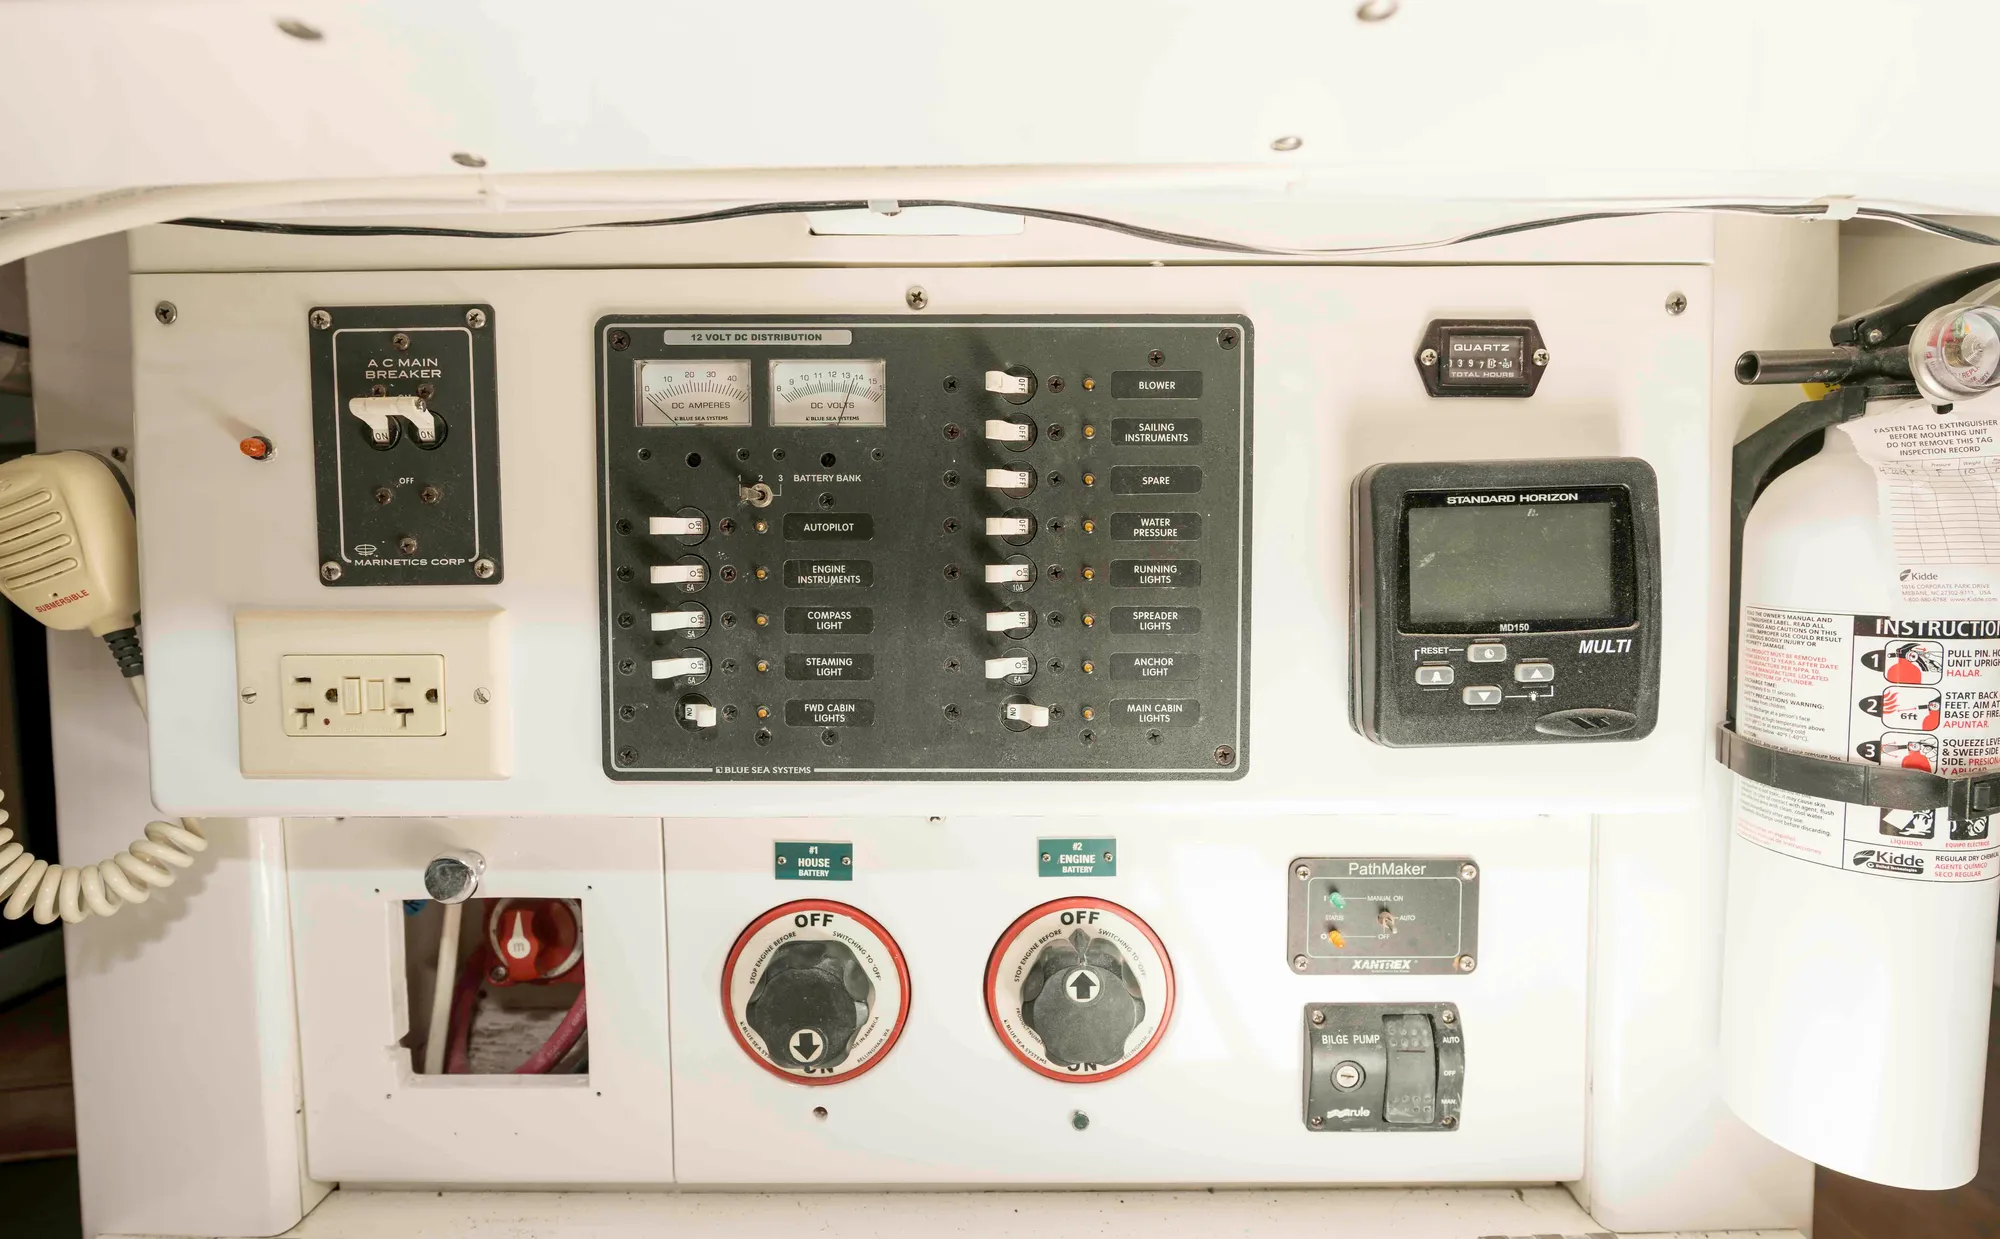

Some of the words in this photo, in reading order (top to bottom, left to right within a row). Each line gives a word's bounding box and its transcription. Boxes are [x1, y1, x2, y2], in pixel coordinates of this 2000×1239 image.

[1454, 344, 1510, 352] QUARTZ
[368, 359, 378, 367] A
[383, 359, 393, 367] C
[399, 358, 438, 367] MAIN
[366, 370, 441, 379] BREAKER
[1018, 378, 1026, 392] OFF
[1139, 381, 1176, 390] BLOWER
[1139, 423, 1174, 432] SAILING
[1874, 426, 1906, 434] FASTEN
[1940, 420, 1998, 429] EXTINGUISHER
[376, 432, 388, 441] ON
[421, 430, 434, 439] ON
[1018, 425, 1026, 439] OFF
[1920, 430, 1967, 438] MOUNTING
[1125, 434, 1188, 442] INSTRUMENTS
[1919, 439, 1954, 447] REMOVE
[1900, 448, 1946, 456] INSPECTION
[1018, 473, 1026, 487] OFF
[1142, 477, 1170, 485] SPARE
[1447, 495, 1516, 504] STANDARD
[1520, 493, 1578, 502] HORIZON
[1018, 519, 1026, 533] OFF
[1141, 518, 1171, 527] WATER
[804, 523, 854, 532] AUTOPILOT
[1134, 528, 1178, 537] PRESSURE
[431, 558, 465, 566] CORP
[812, 565, 846, 573] ENGINE
[1134, 566, 1177, 574] RUNNING
[798, 576, 860, 584] INSTRUMENTS
[1140, 576, 1171, 584] LIGHTS
[1912, 573, 1938, 581] Kidde
[1013, 584, 1023, 592] 10A
[35, 590, 89, 613] SUBMERSIBLE
[808, 612, 851, 620] COMPASS
[1133, 612, 1178, 621] SPREADER
[817, 622, 842, 630] LIGHT
[1140, 622, 1171, 630] LIGHTS
[1500, 623, 1529, 632] MD150
[1876, 619, 2000, 636] INSTRUCTIO
[1579, 640, 1631, 654] MULTI
[1948, 650, 1972, 658] PULL
[1975, 650, 1990, 658] PIN.
[806, 658, 853, 666] STEAMING
[1134, 658, 1173, 667] ANCHOR
[1871, 654, 1879, 668] 1
[817, 668, 842, 676] LIGHT
[1142, 668, 1168, 676] LIGHT
[1014, 676, 1022, 684] 5A
[1979, 691, 1998, 699] BACK
[804, 704, 824, 712] FWD
[826, 704, 855, 712] CABIN
[1127, 704, 1153, 713] MAIN
[1155, 704, 1183, 713] CABIN
[1867, 699, 1878, 713] 2
[814, 714, 845, 722] LIGHTS
[1139, 714, 1170, 723] LIGHTS
[1901, 713, 1918, 721] 6ft
[1943, 739, 1984, 748] SQUEEZE
[1865, 744, 1875, 758] 3
[1985, 747, 1999, 756] SIDE
[1942, 758, 1966, 766] SIDE.
[809, 846, 818, 855] #1
[1073, 843, 1082, 851] #2
[798, 858, 830, 868] HOUSE
[1060, 855, 1095, 864] ENGINE
[1876, 851, 1924, 867] Kidde
[1349, 863, 1426, 876] PathMaker
[795, 914, 834, 928] OFF
[1060, 911, 1100, 925] OFF
[833, 931, 866, 955] SWITCHING
[1099, 928, 1132, 953] SWITCHING
[755, 945, 774, 968] ENGINE
[774, 931, 797, 947] BEFORE
[1021, 943, 1039, 965] ENGINE
[1039, 929, 1062, 944] BEFORE
[1353, 960, 1413, 969] XANTREX
[1322, 1035, 1348, 1044] BILGE
[1354, 1035, 1380, 1044] PUMP
